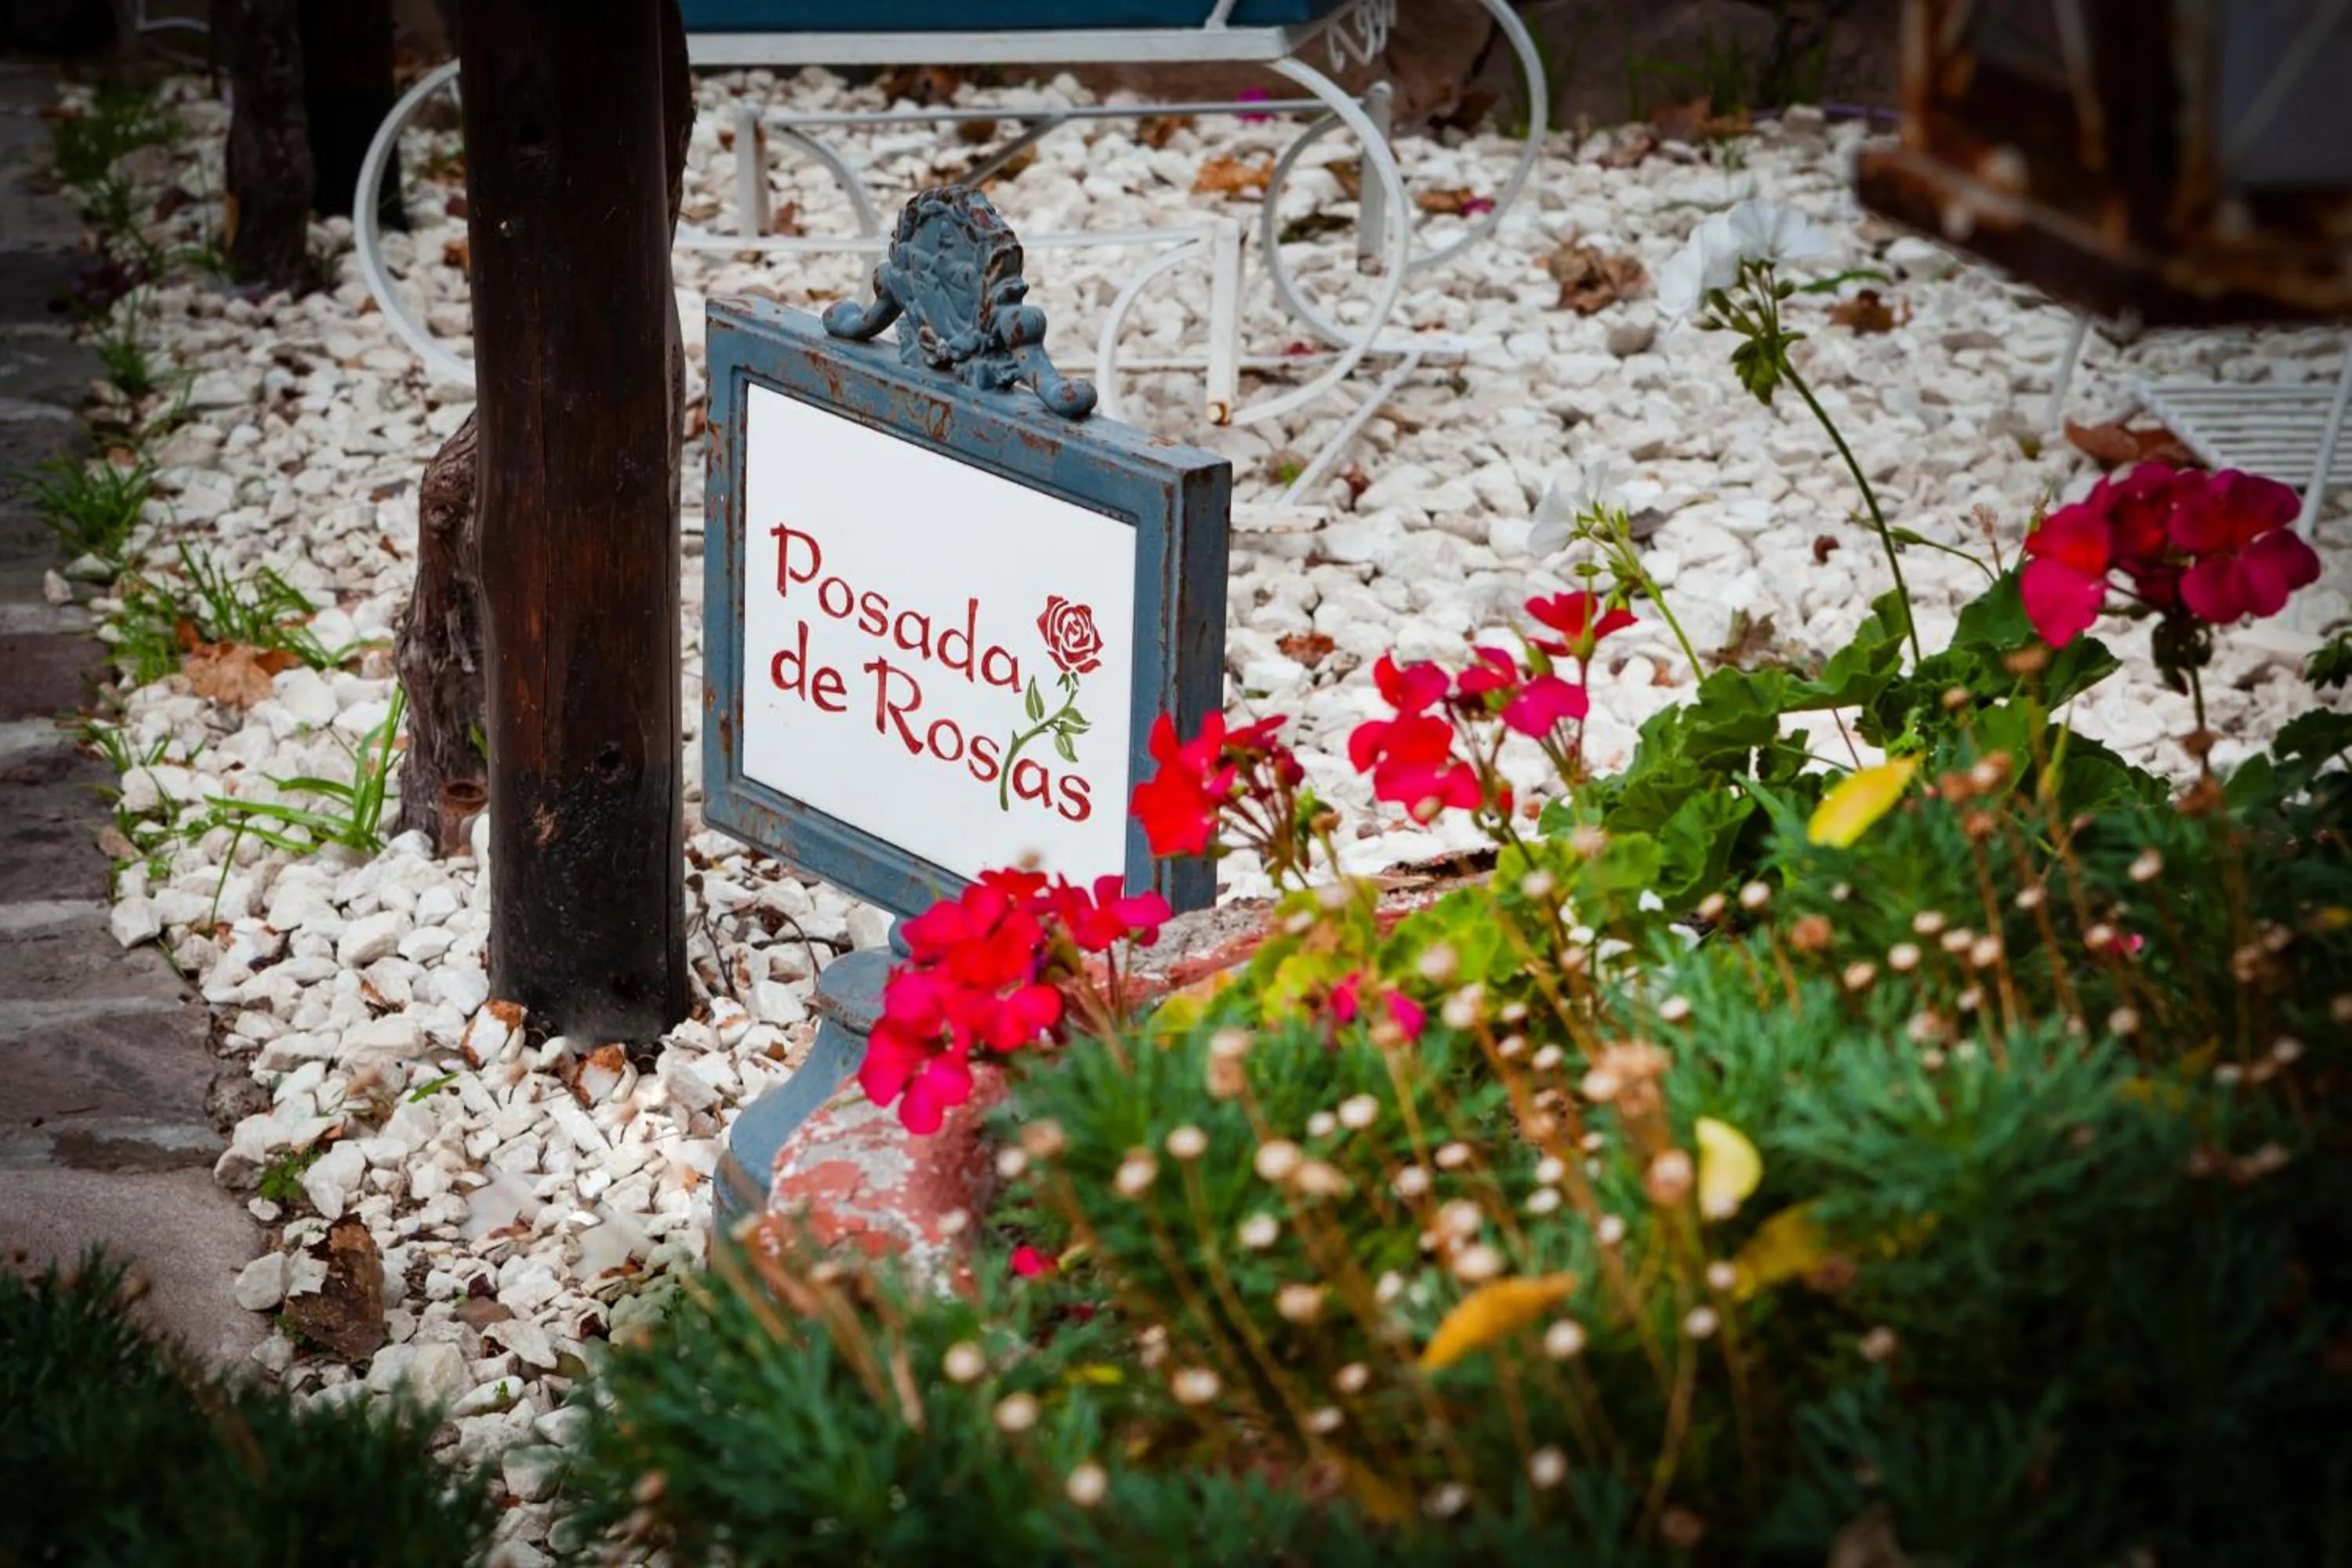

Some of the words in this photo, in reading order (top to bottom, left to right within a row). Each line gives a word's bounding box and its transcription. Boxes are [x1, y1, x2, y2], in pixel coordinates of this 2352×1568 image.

[768, 522, 1023, 695] Posada
[769, 619, 848, 713] de
[862, 655, 1093, 824] Rosas
